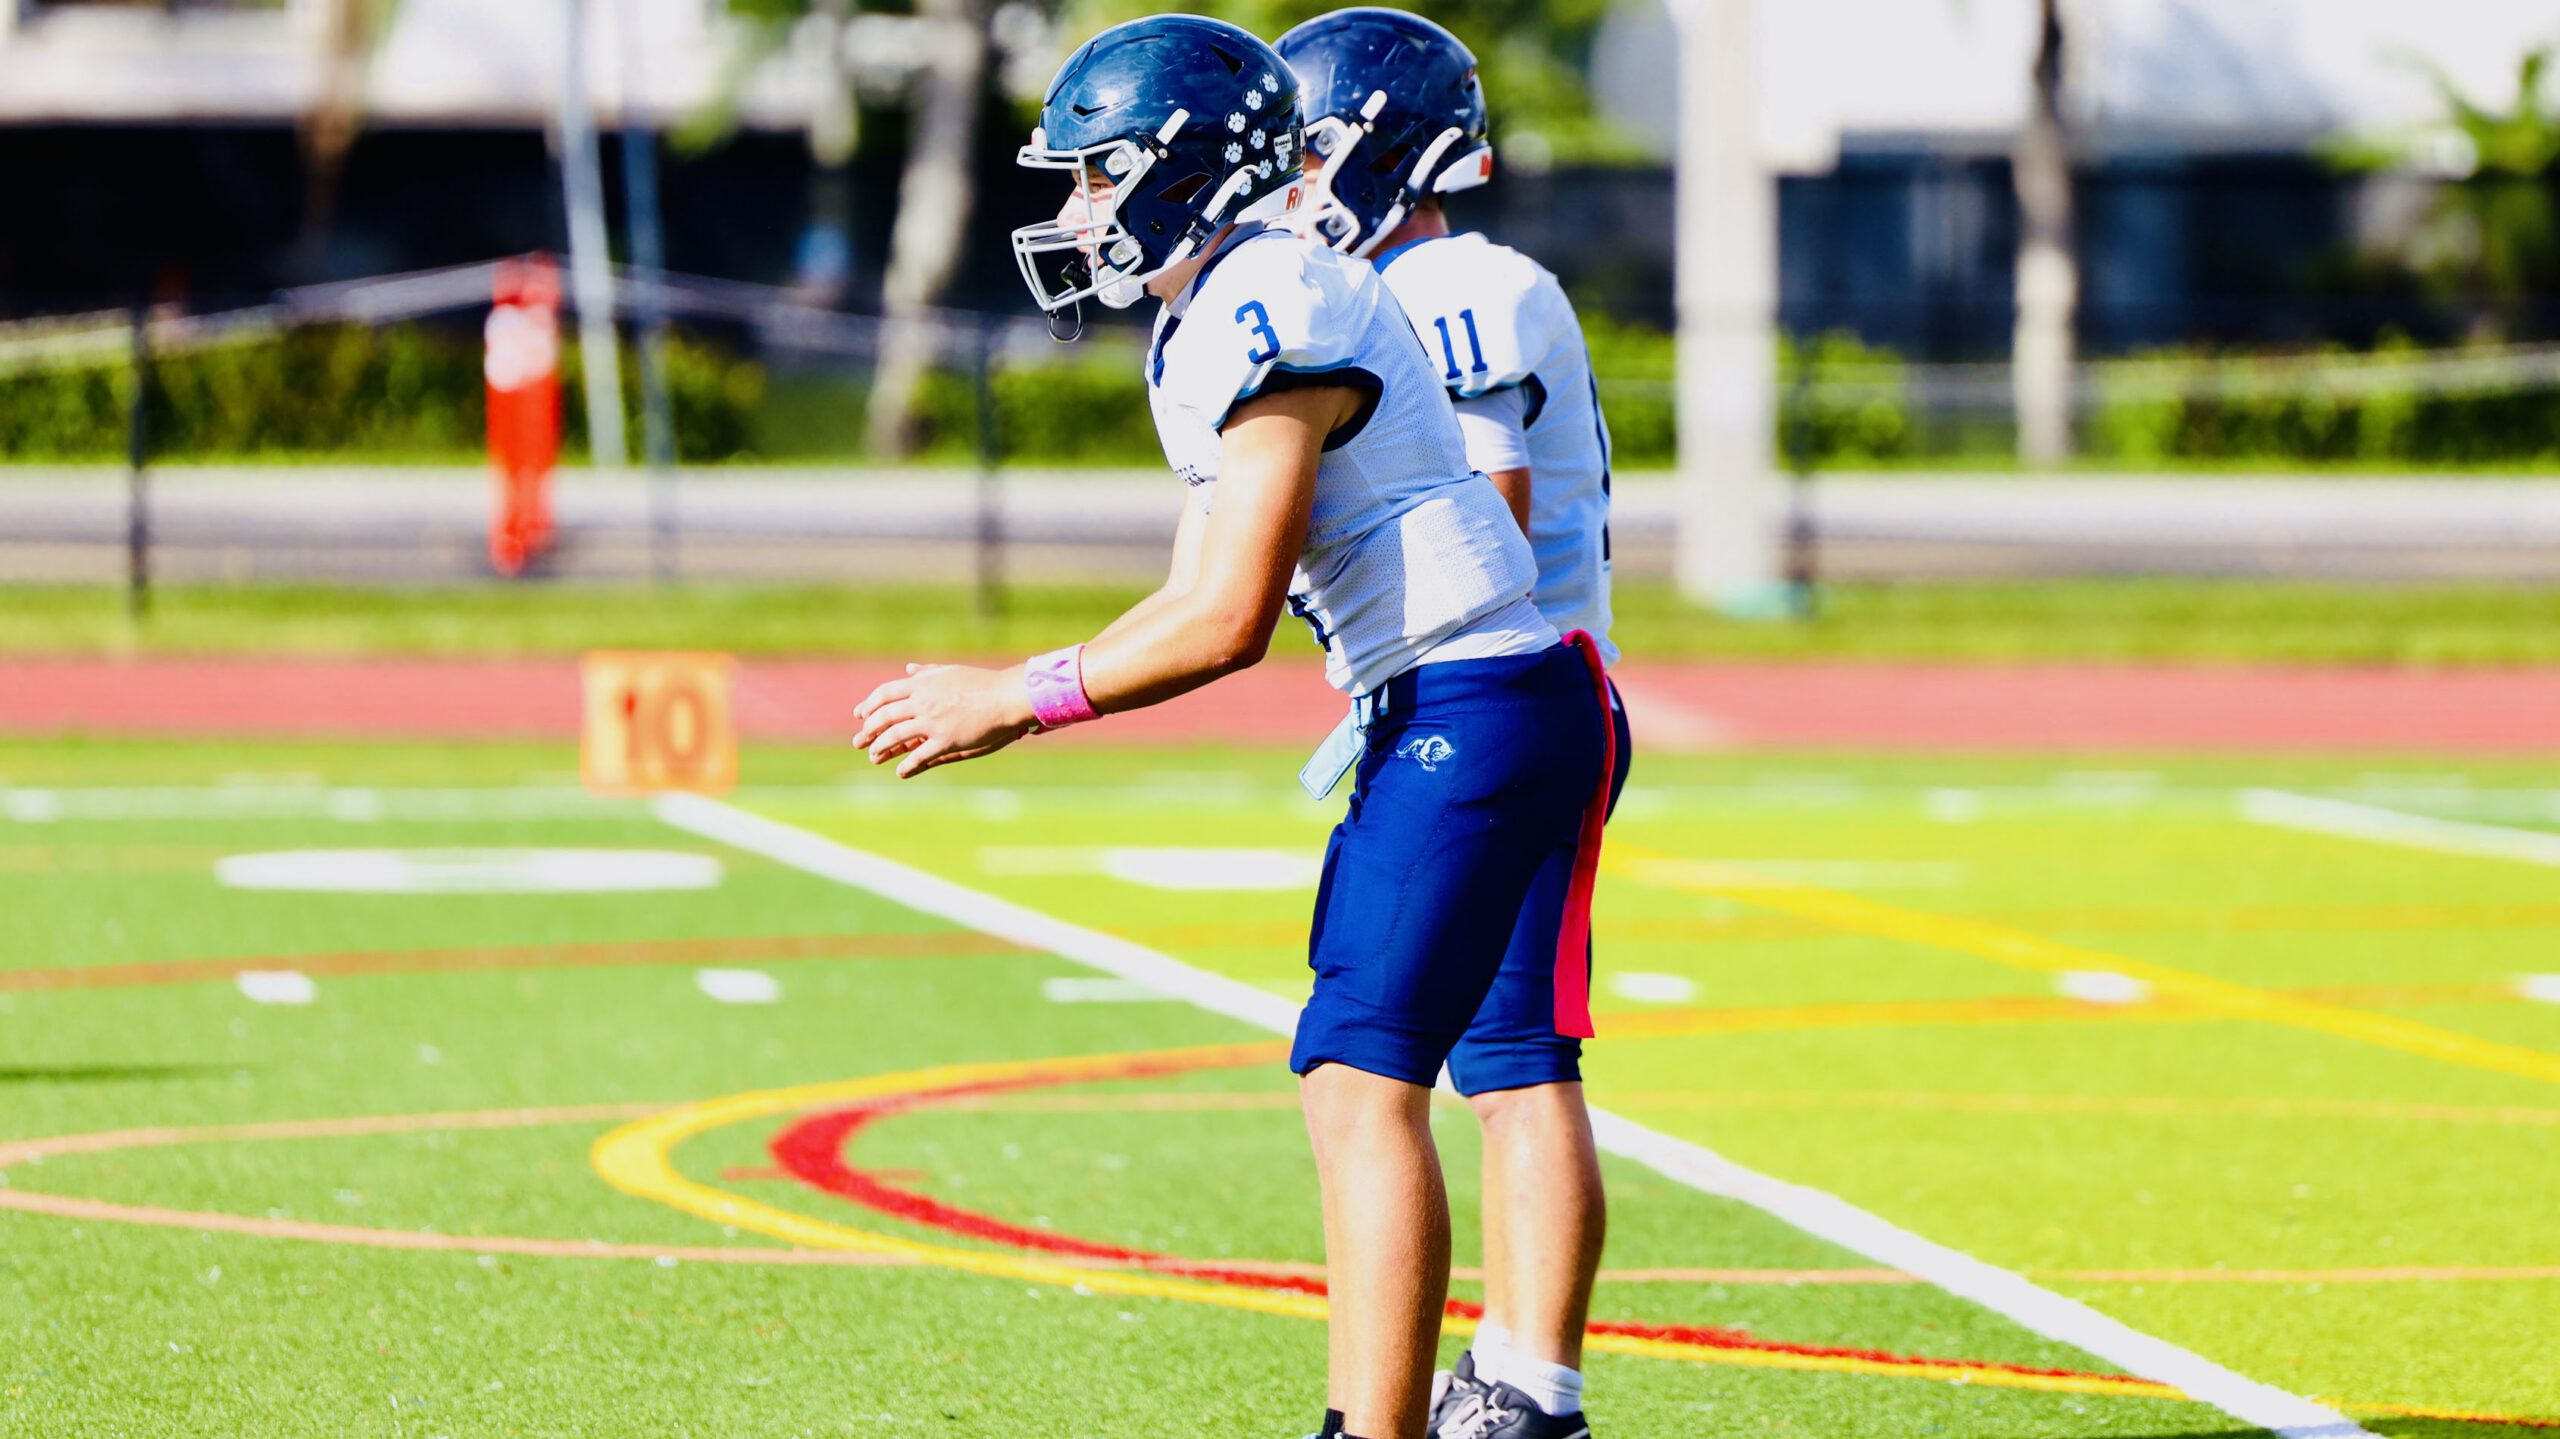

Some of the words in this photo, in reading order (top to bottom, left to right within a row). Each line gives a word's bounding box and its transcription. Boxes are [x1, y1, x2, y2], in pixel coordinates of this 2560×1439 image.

[1235, 300, 1281, 364] 3
[1434, 308, 1488, 380] 11
[613, 681, 709, 780] 10
